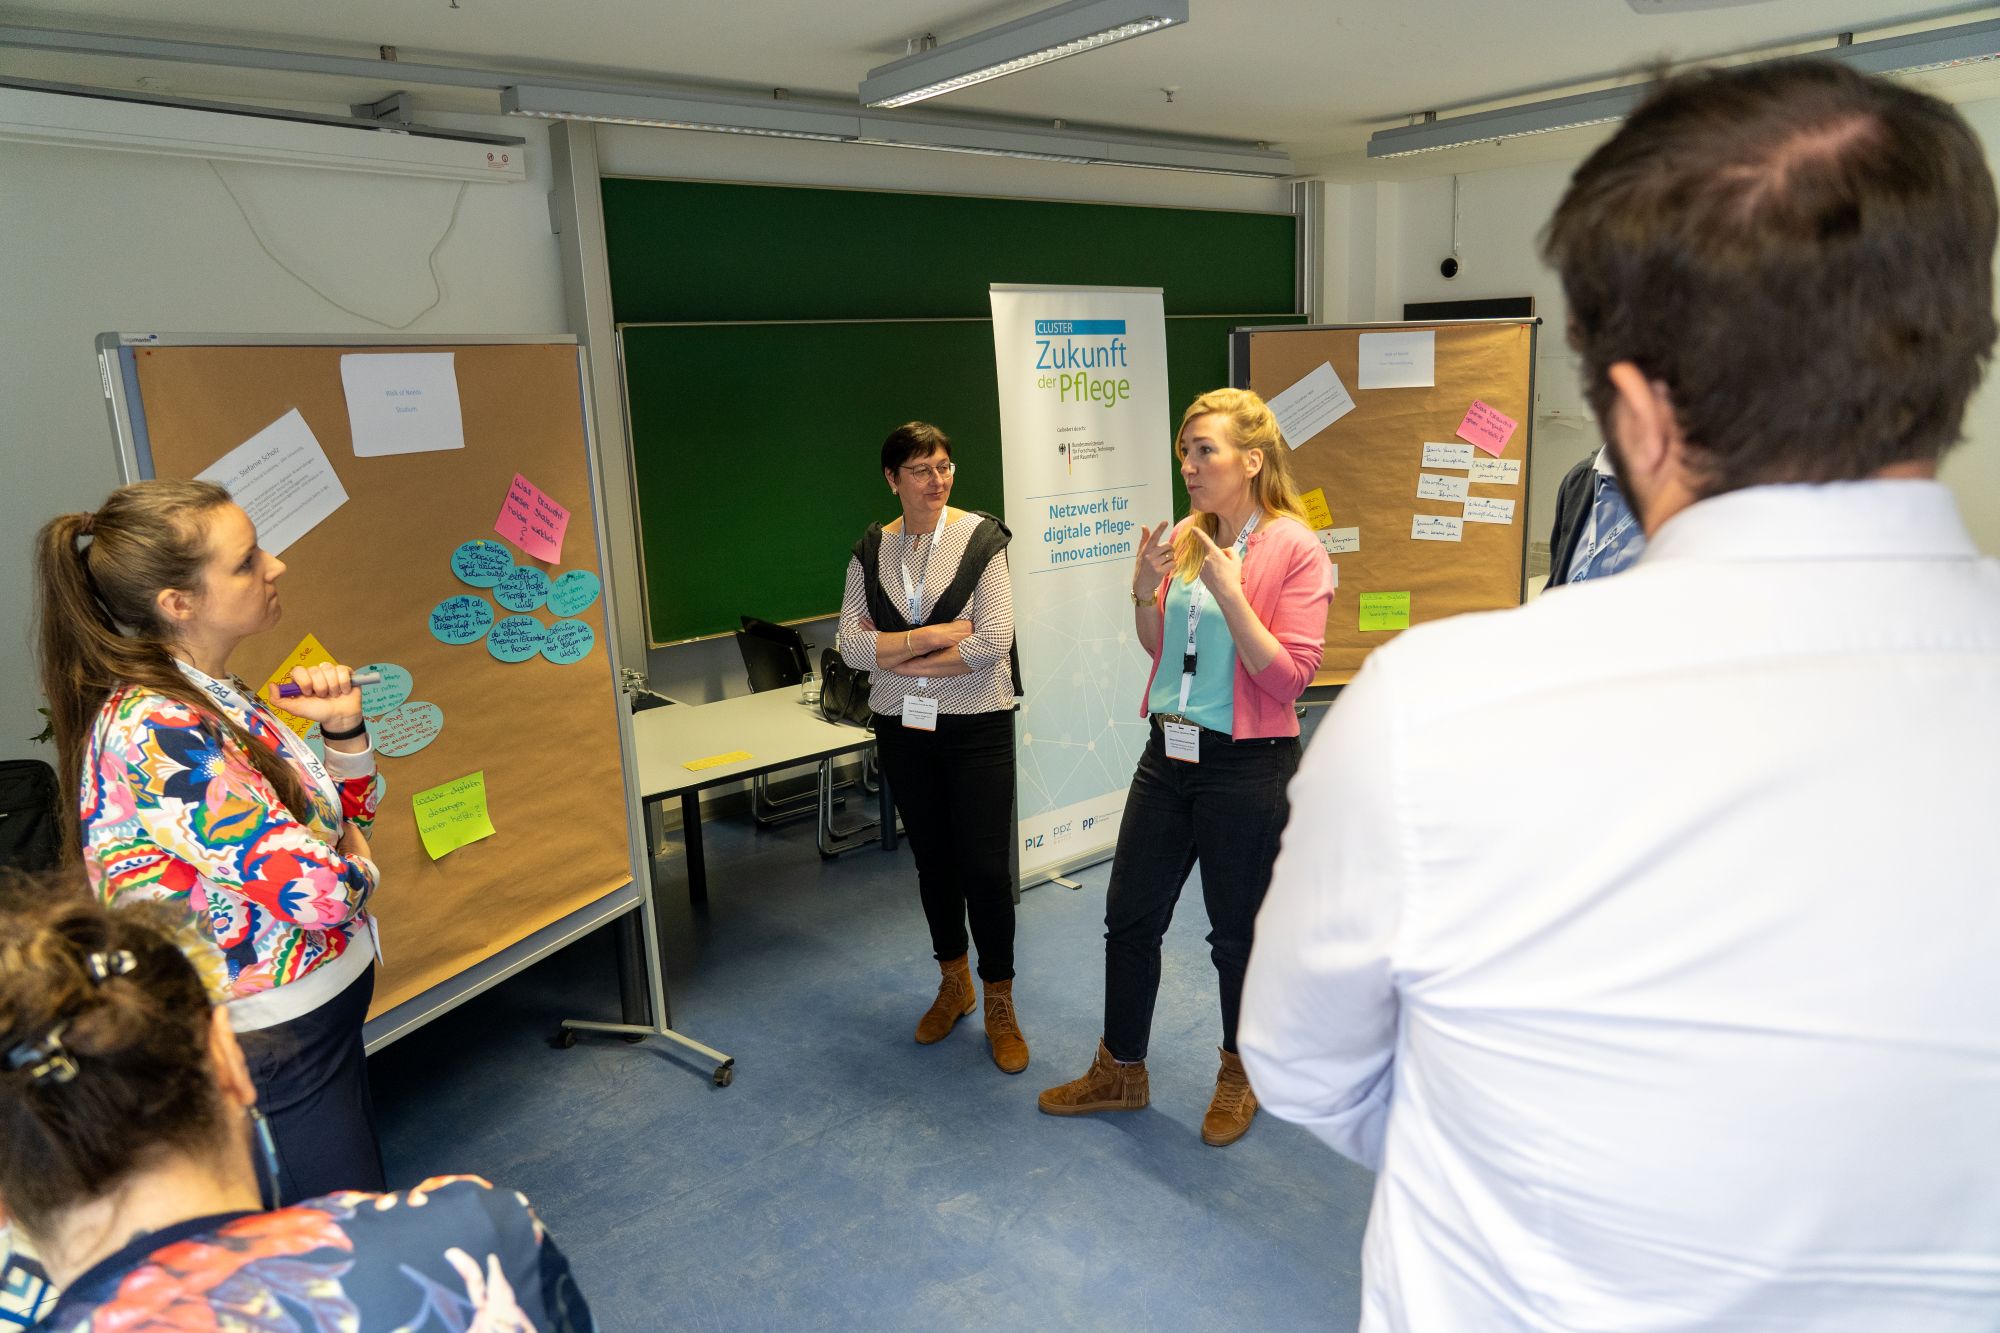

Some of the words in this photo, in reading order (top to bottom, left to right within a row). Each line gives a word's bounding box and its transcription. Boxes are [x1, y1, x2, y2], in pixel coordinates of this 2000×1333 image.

[1037, 322, 1073, 334] CLUSTER
[1035, 338, 1127, 369] Zukunft
[1037, 374, 1057, 389] der
[1060, 371, 1130, 408] Pflege
[261, 447, 280, 462] Scholz
[1049, 498, 1108, 519] Netzwerk
[1112, 496, 1128, 511] für
[1043, 522, 1091, 544] digitale
[1095, 518, 1135, 535] Pflege-
[1050, 541, 1131, 564] innovationen
[205, 680, 231, 699] PPZ
[307, 758, 326, 779] PPZ
